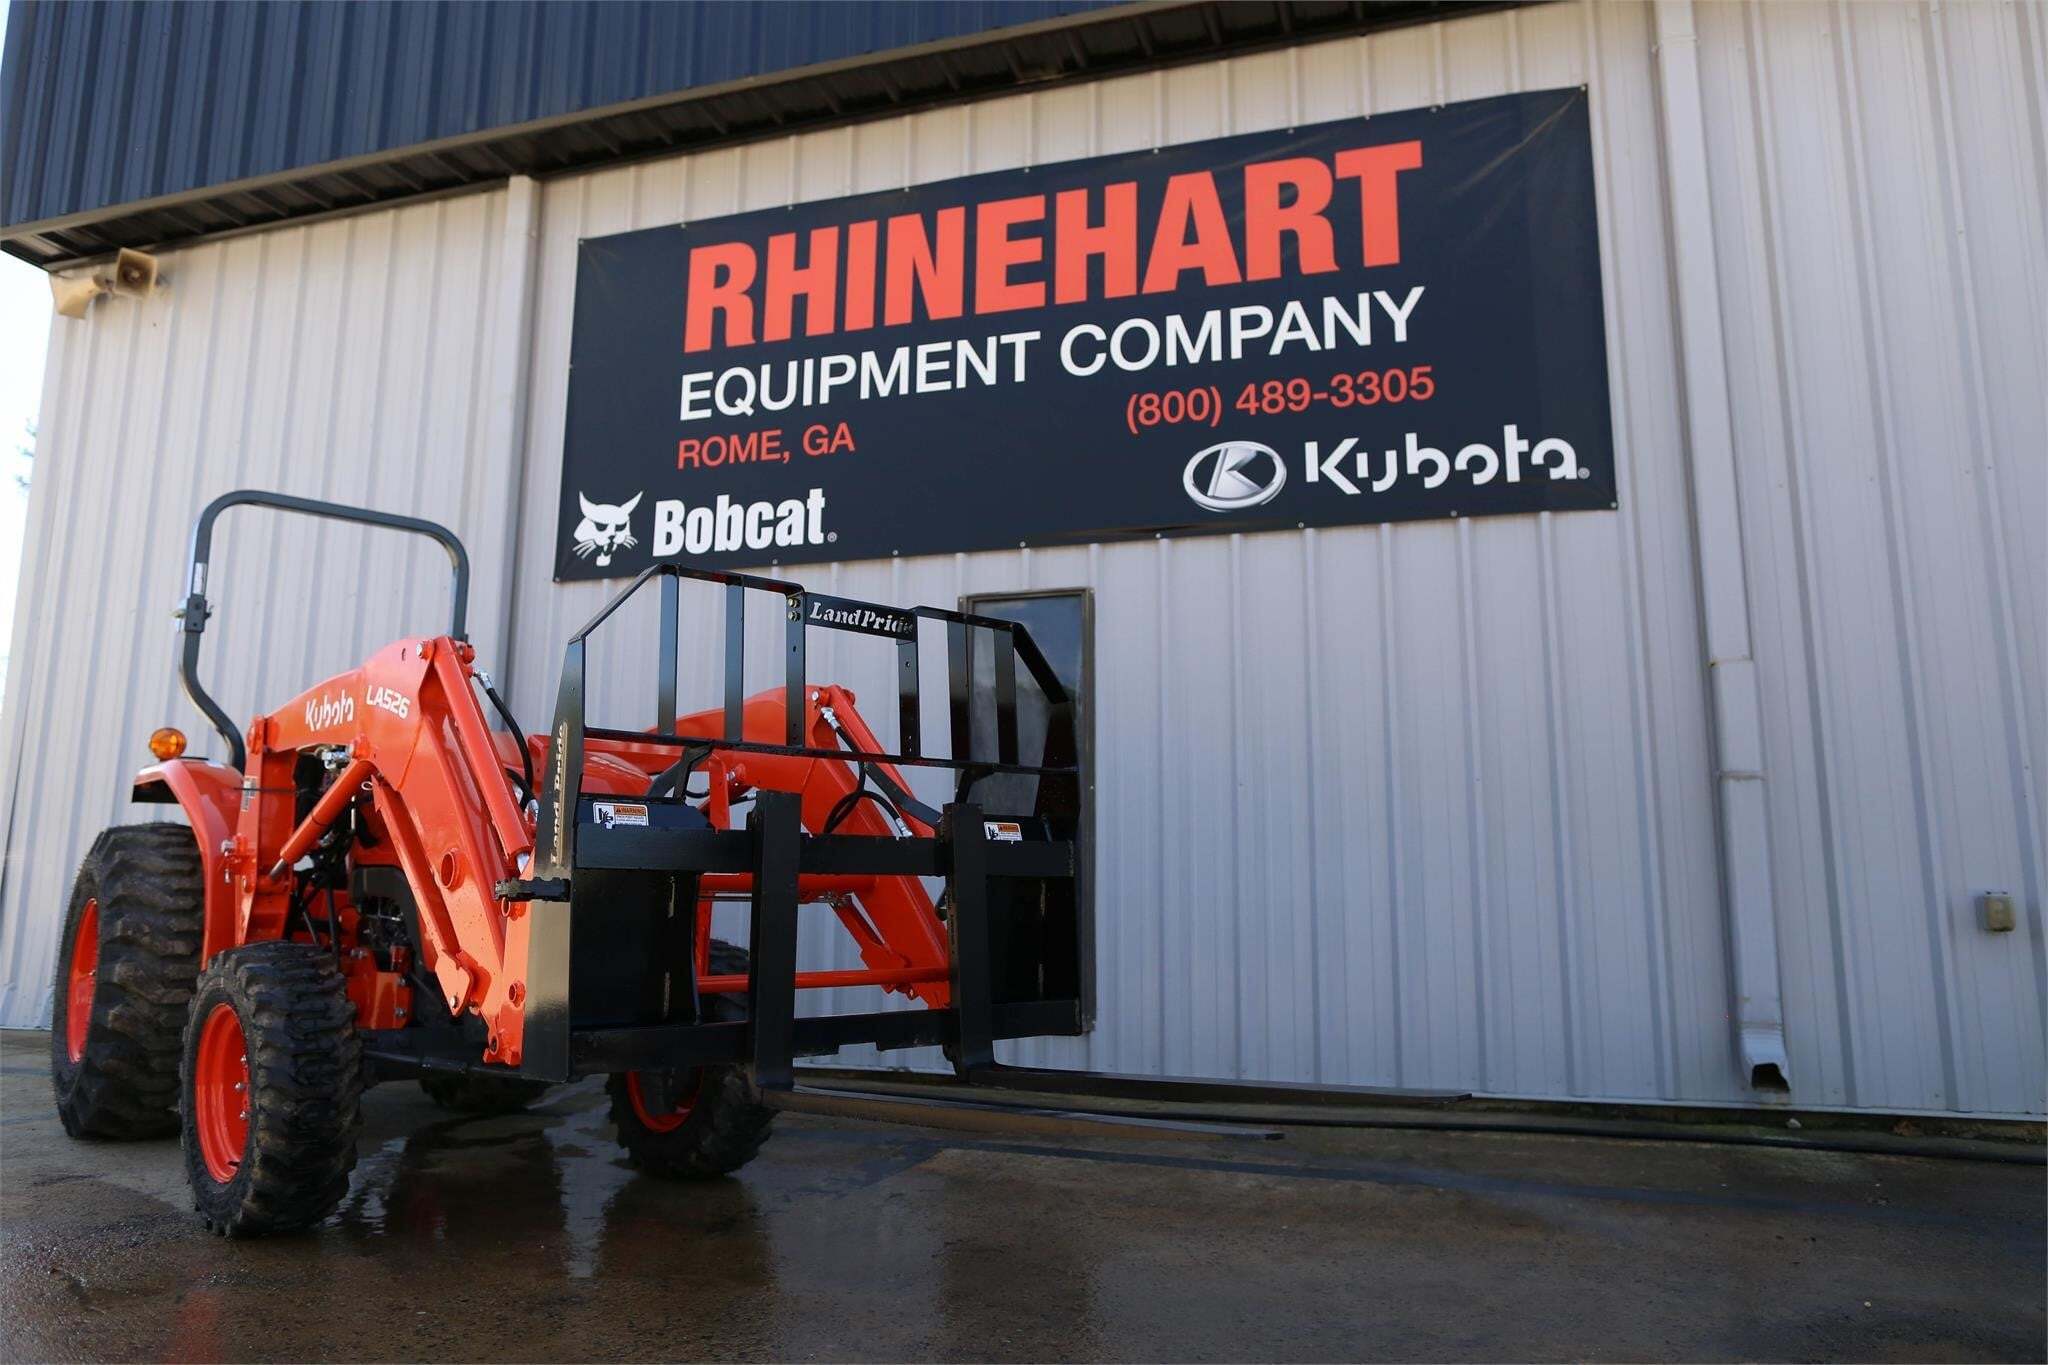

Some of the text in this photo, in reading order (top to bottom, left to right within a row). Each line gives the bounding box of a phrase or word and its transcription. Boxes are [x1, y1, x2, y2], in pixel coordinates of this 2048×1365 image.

[683, 140, 1423, 353] RHINEHART
[679, 285, 1426, 421] EQUIPMENT COMPANY
[1125, 365, 1436, 435] (800) 489-3305
[676, 422, 856, 470] ROME, GA
[1304, 423, 1578, 495] Kubota
[652, 487, 826, 557] Bobcat
[305, 689, 354, 732] Kubota
[366, 684, 411, 719] LA526
